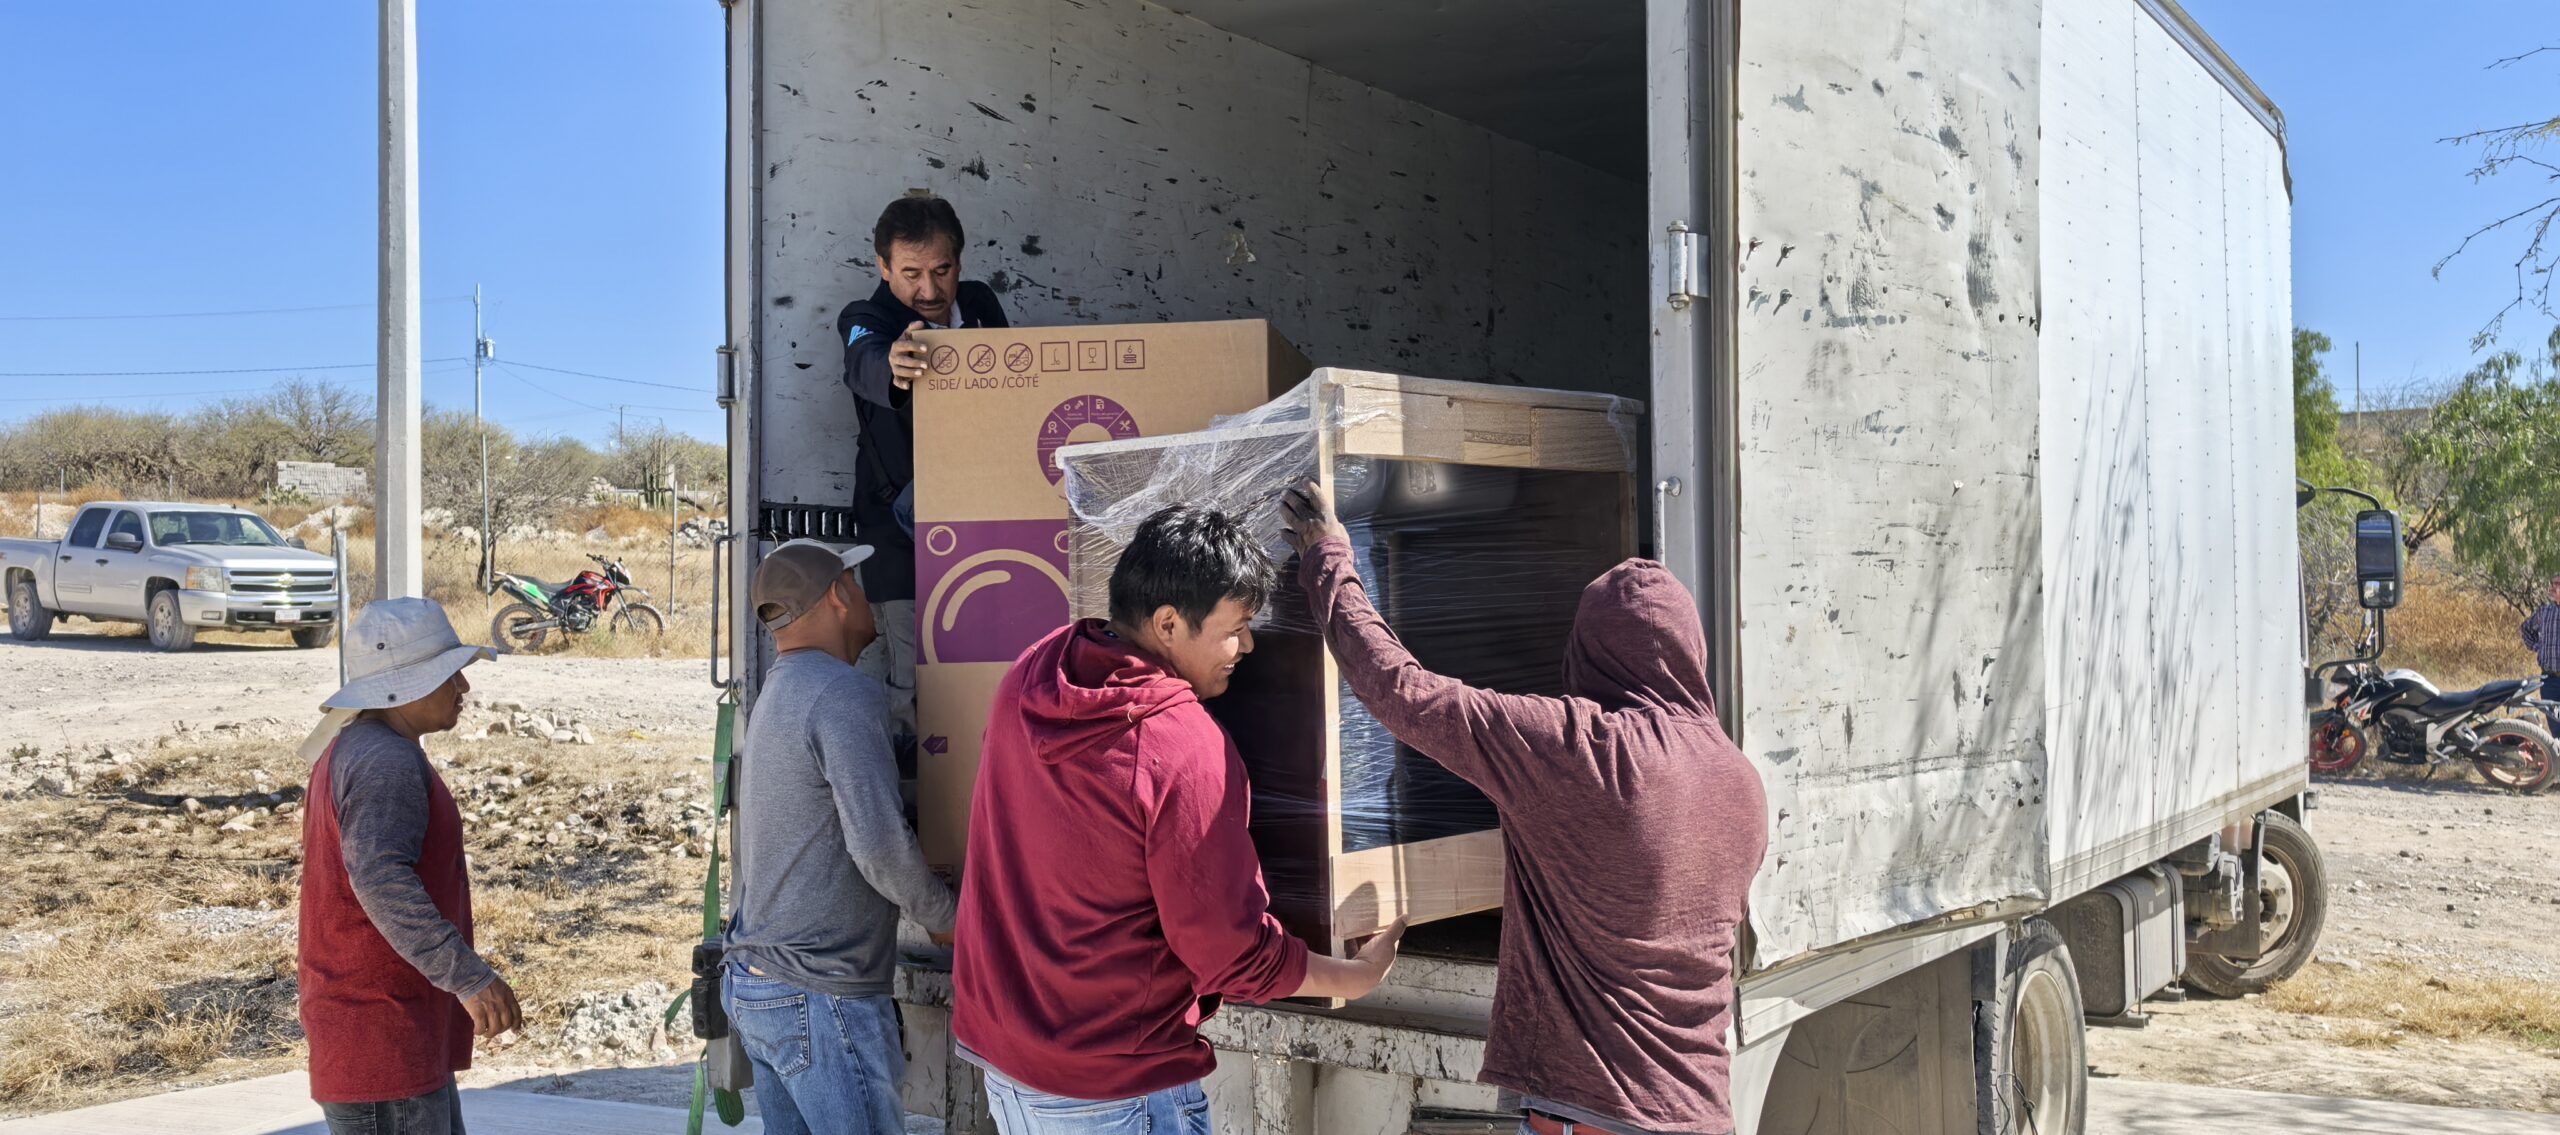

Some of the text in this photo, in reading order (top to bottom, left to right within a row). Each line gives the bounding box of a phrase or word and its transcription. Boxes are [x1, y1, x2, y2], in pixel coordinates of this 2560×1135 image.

[928, 373, 1040, 391] SIDE/ LADO /CÔTÉ
